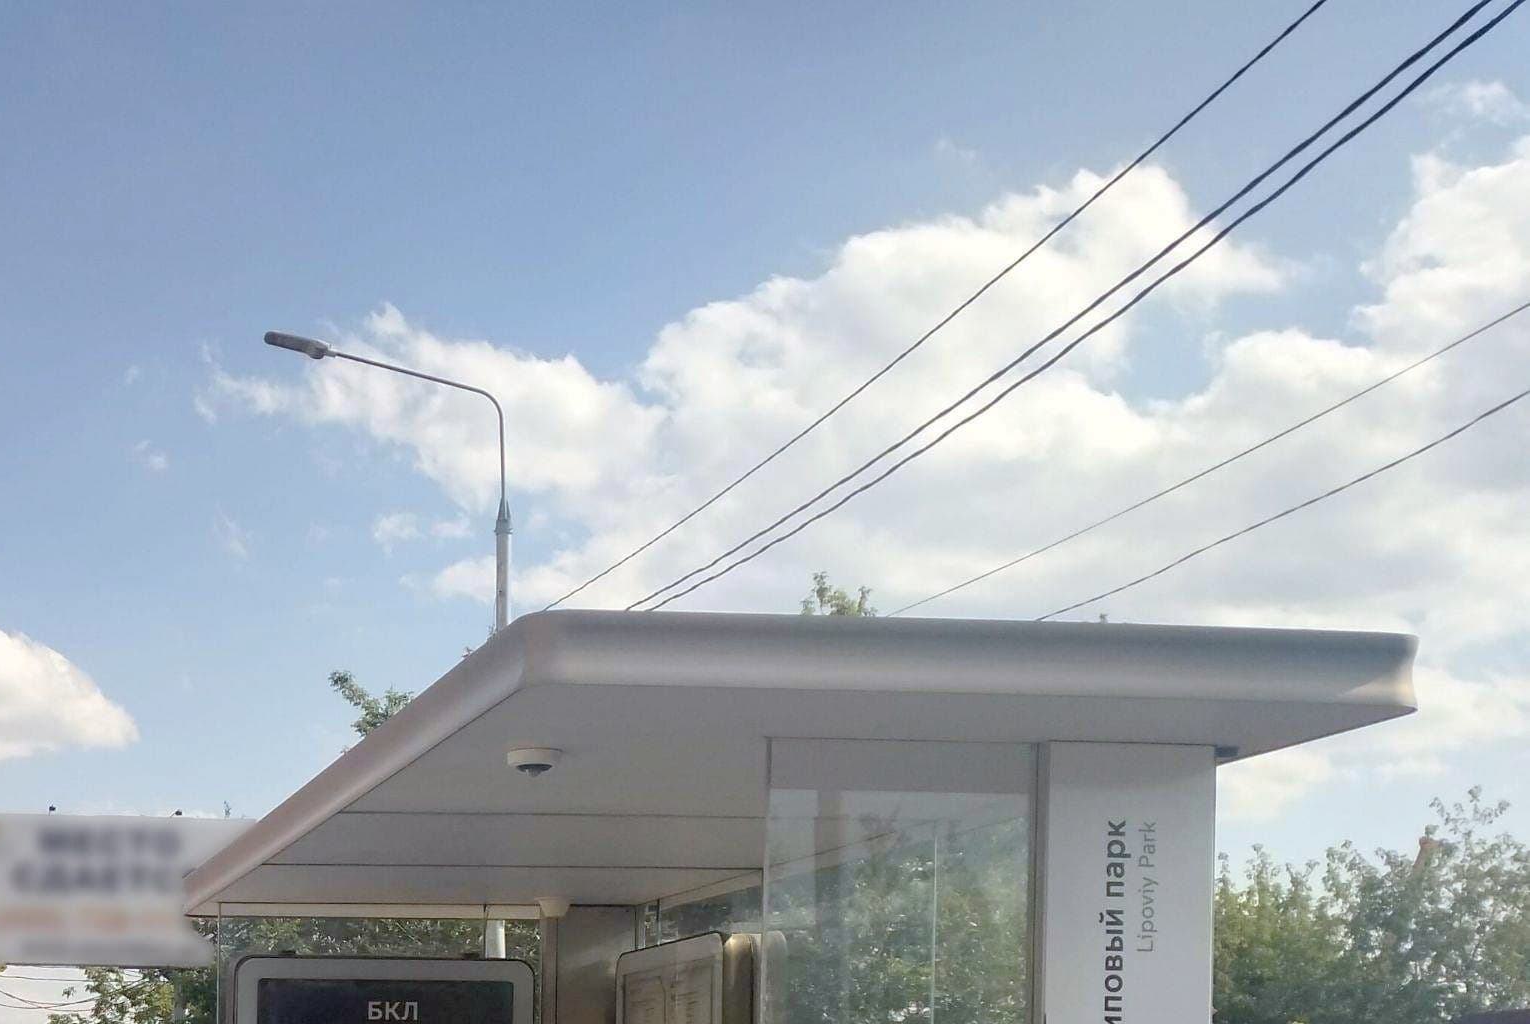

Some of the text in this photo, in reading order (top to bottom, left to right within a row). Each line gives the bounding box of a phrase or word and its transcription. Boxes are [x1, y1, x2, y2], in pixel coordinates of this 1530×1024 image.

[1106, 820, 1132, 898] парк
[1137, 821, 1159, 953] Lipoviy Park
[368, 1001, 419, 1021] БКЛ
